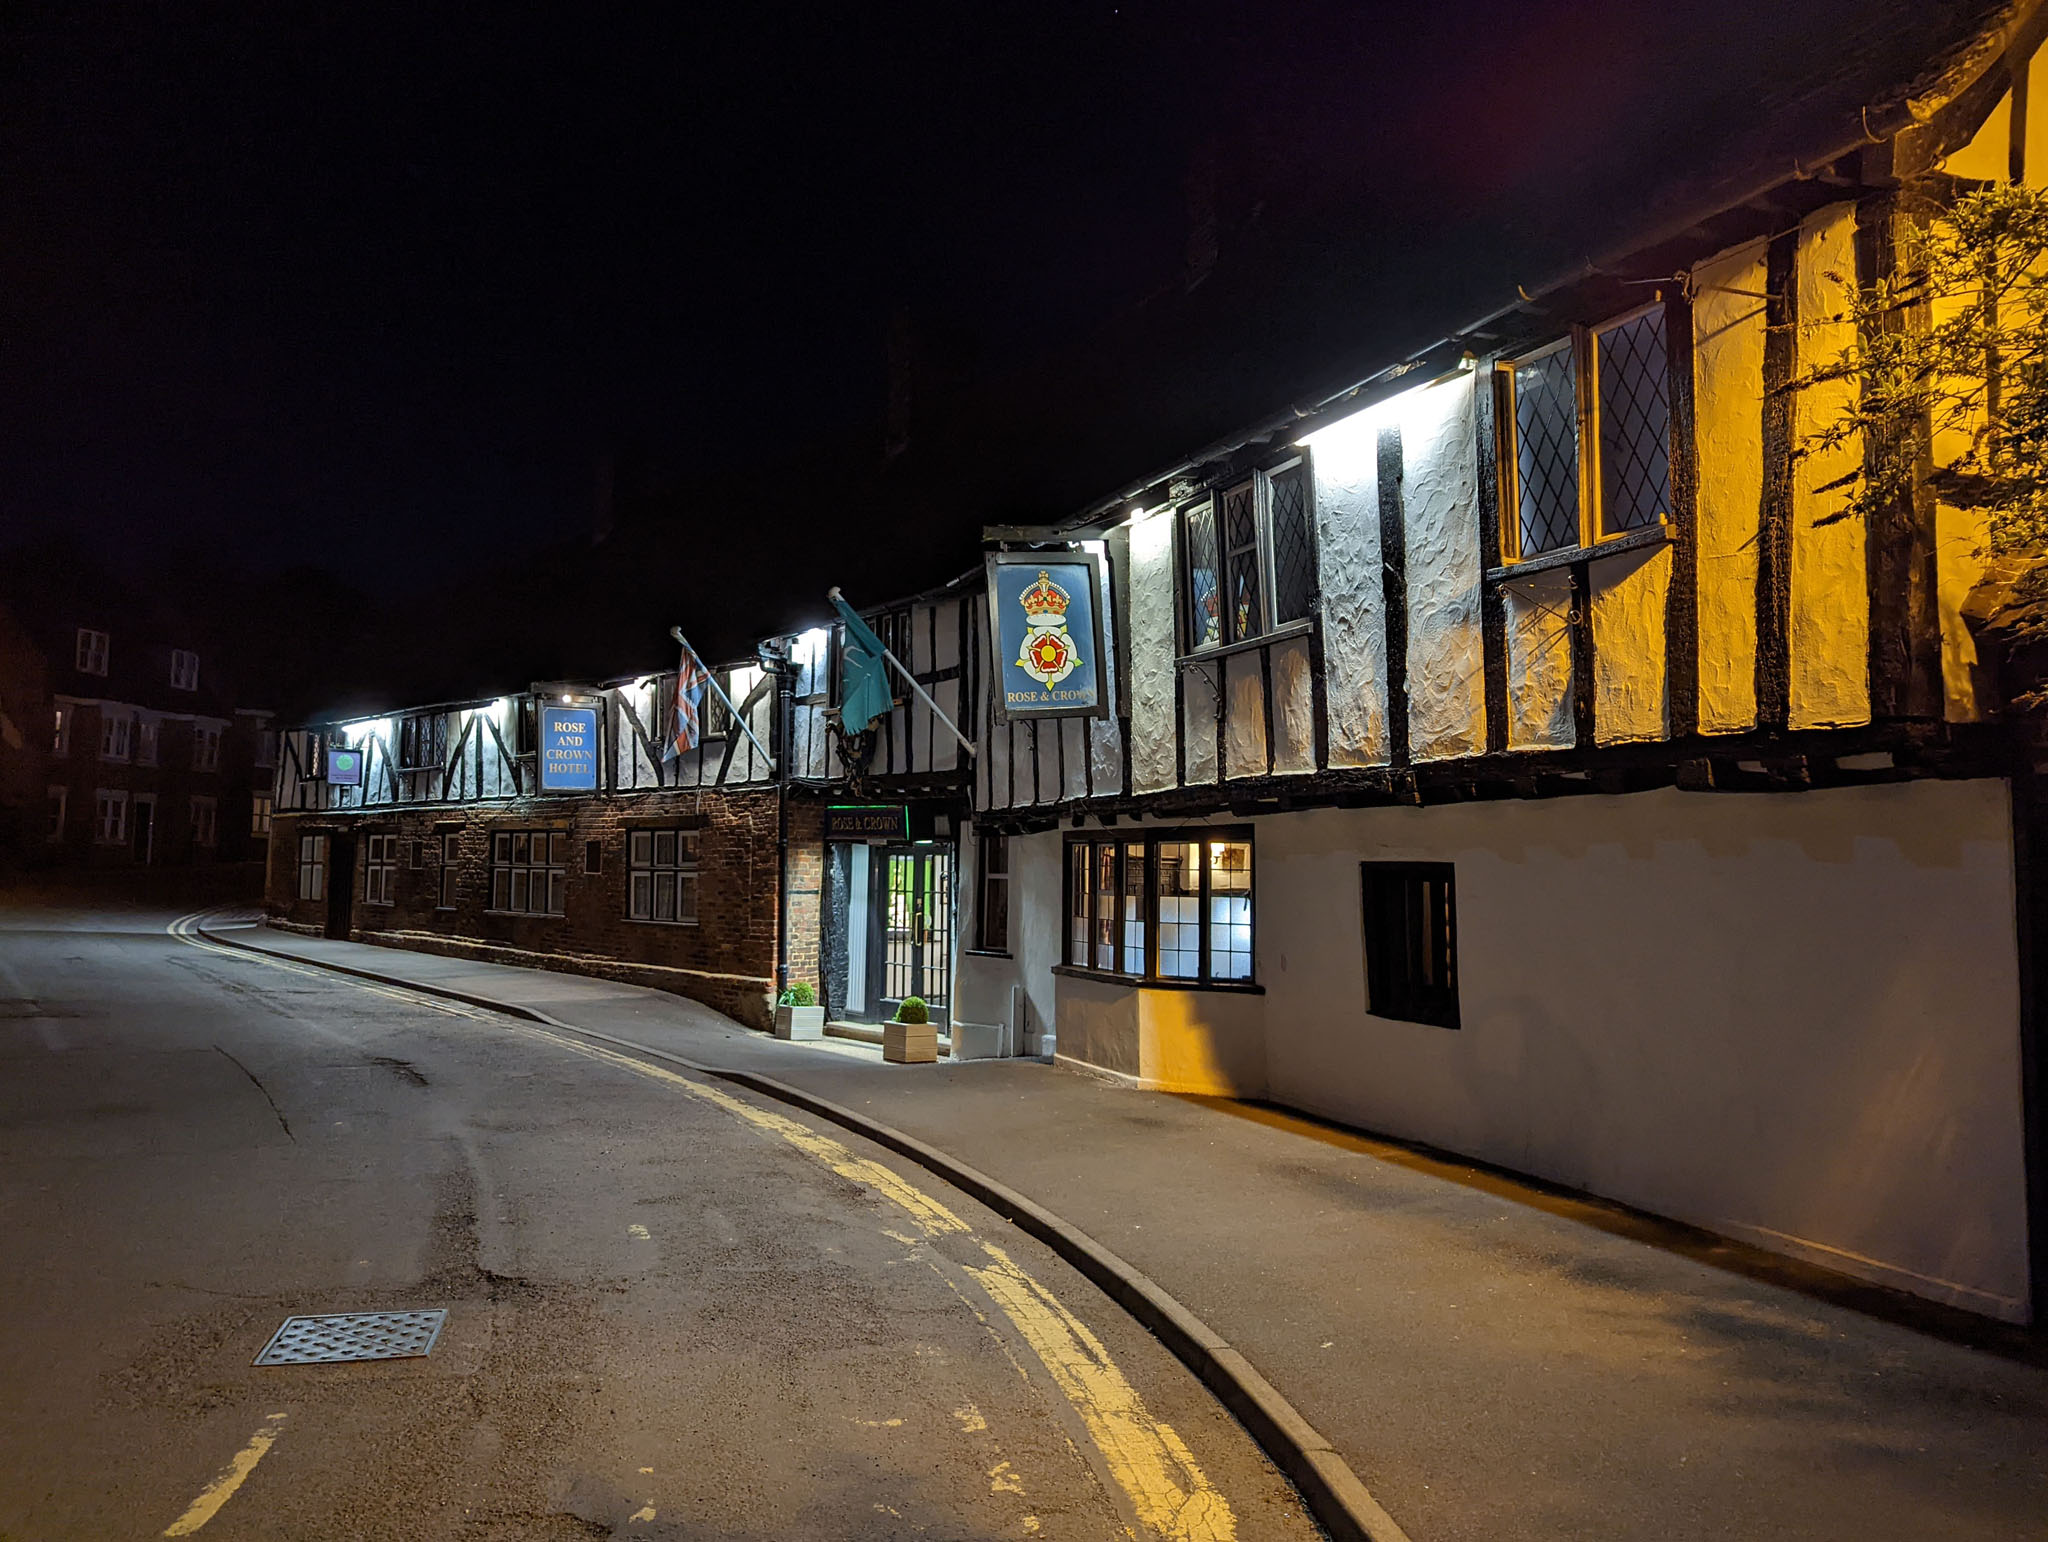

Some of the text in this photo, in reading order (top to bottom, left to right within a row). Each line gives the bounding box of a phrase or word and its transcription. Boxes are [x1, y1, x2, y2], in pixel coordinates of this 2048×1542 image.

[1007, 691, 1038, 703] ROSE
[1040, 691, 1049, 702] &
[554, 721, 586, 733] ROSE
[557, 736, 583, 747] AND
[546, 749, 593, 760] CROWN
[549, 763, 589, 774] HOTEL
[831, 816, 898, 831] ROSE & CROWN
